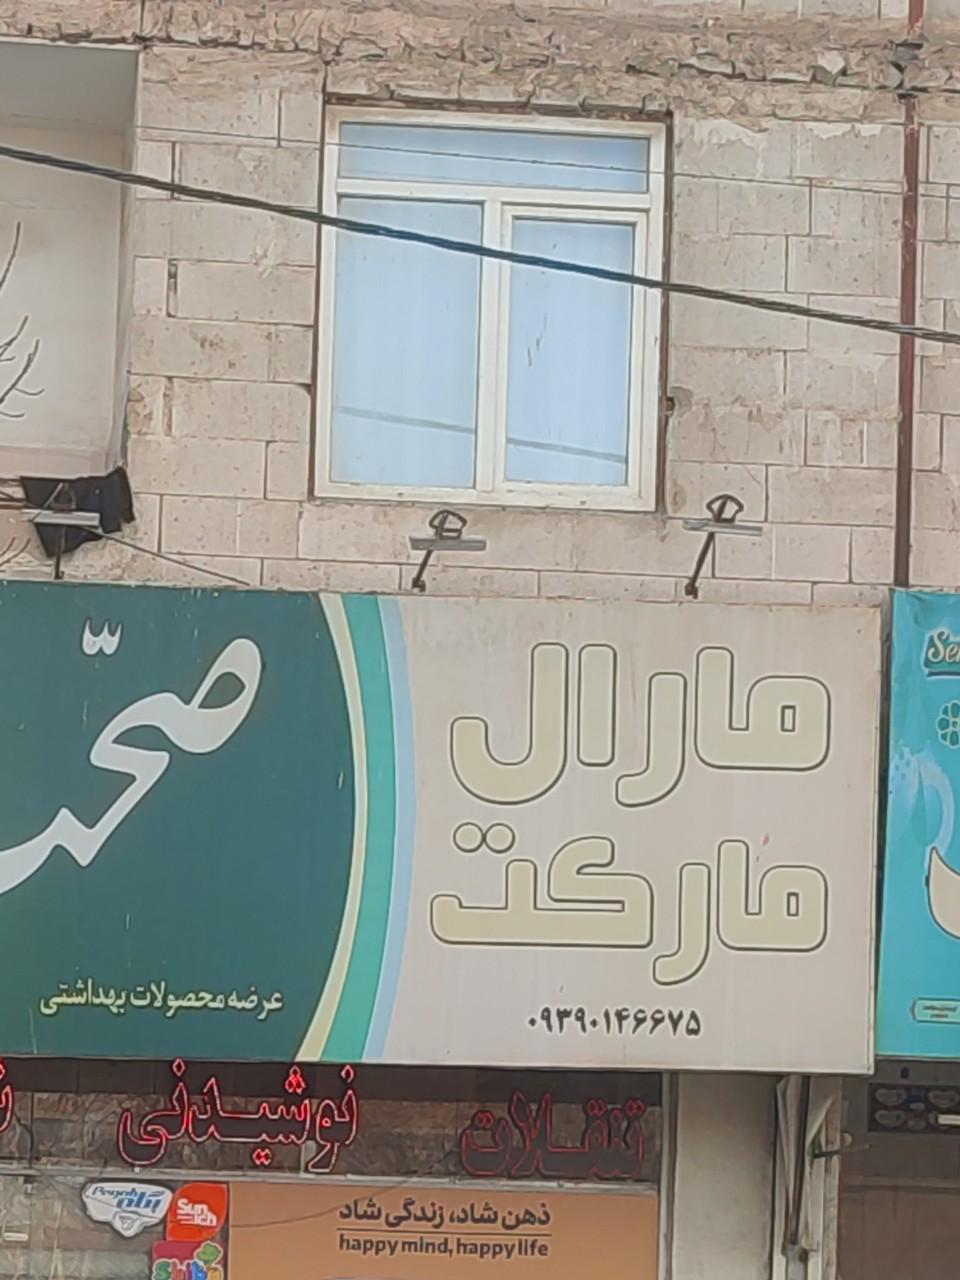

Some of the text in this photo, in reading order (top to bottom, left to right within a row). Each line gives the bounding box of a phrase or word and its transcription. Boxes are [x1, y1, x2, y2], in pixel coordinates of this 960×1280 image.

[450, 642, 831, 807] مارال
[430, 822, 828, 986] مارکت
[40, 978, 284, 1019] عرضه محصولات بهداشتی
[528, 1007, 701, 1036] ۰۹۳۹۰۱۴۶۶۷۵
[118, 1058, 358, 1172] نوشیدنی
[339, 1199, 382, 1221] شاد
[385, 1198, 445, 1228] زندگی
[501, 1202, 551, 1230] ذهن
[339, 1234, 399, 1256] happy
[456, 1238, 515, 1259] happy
[518, 1239, 549, 1257] life
